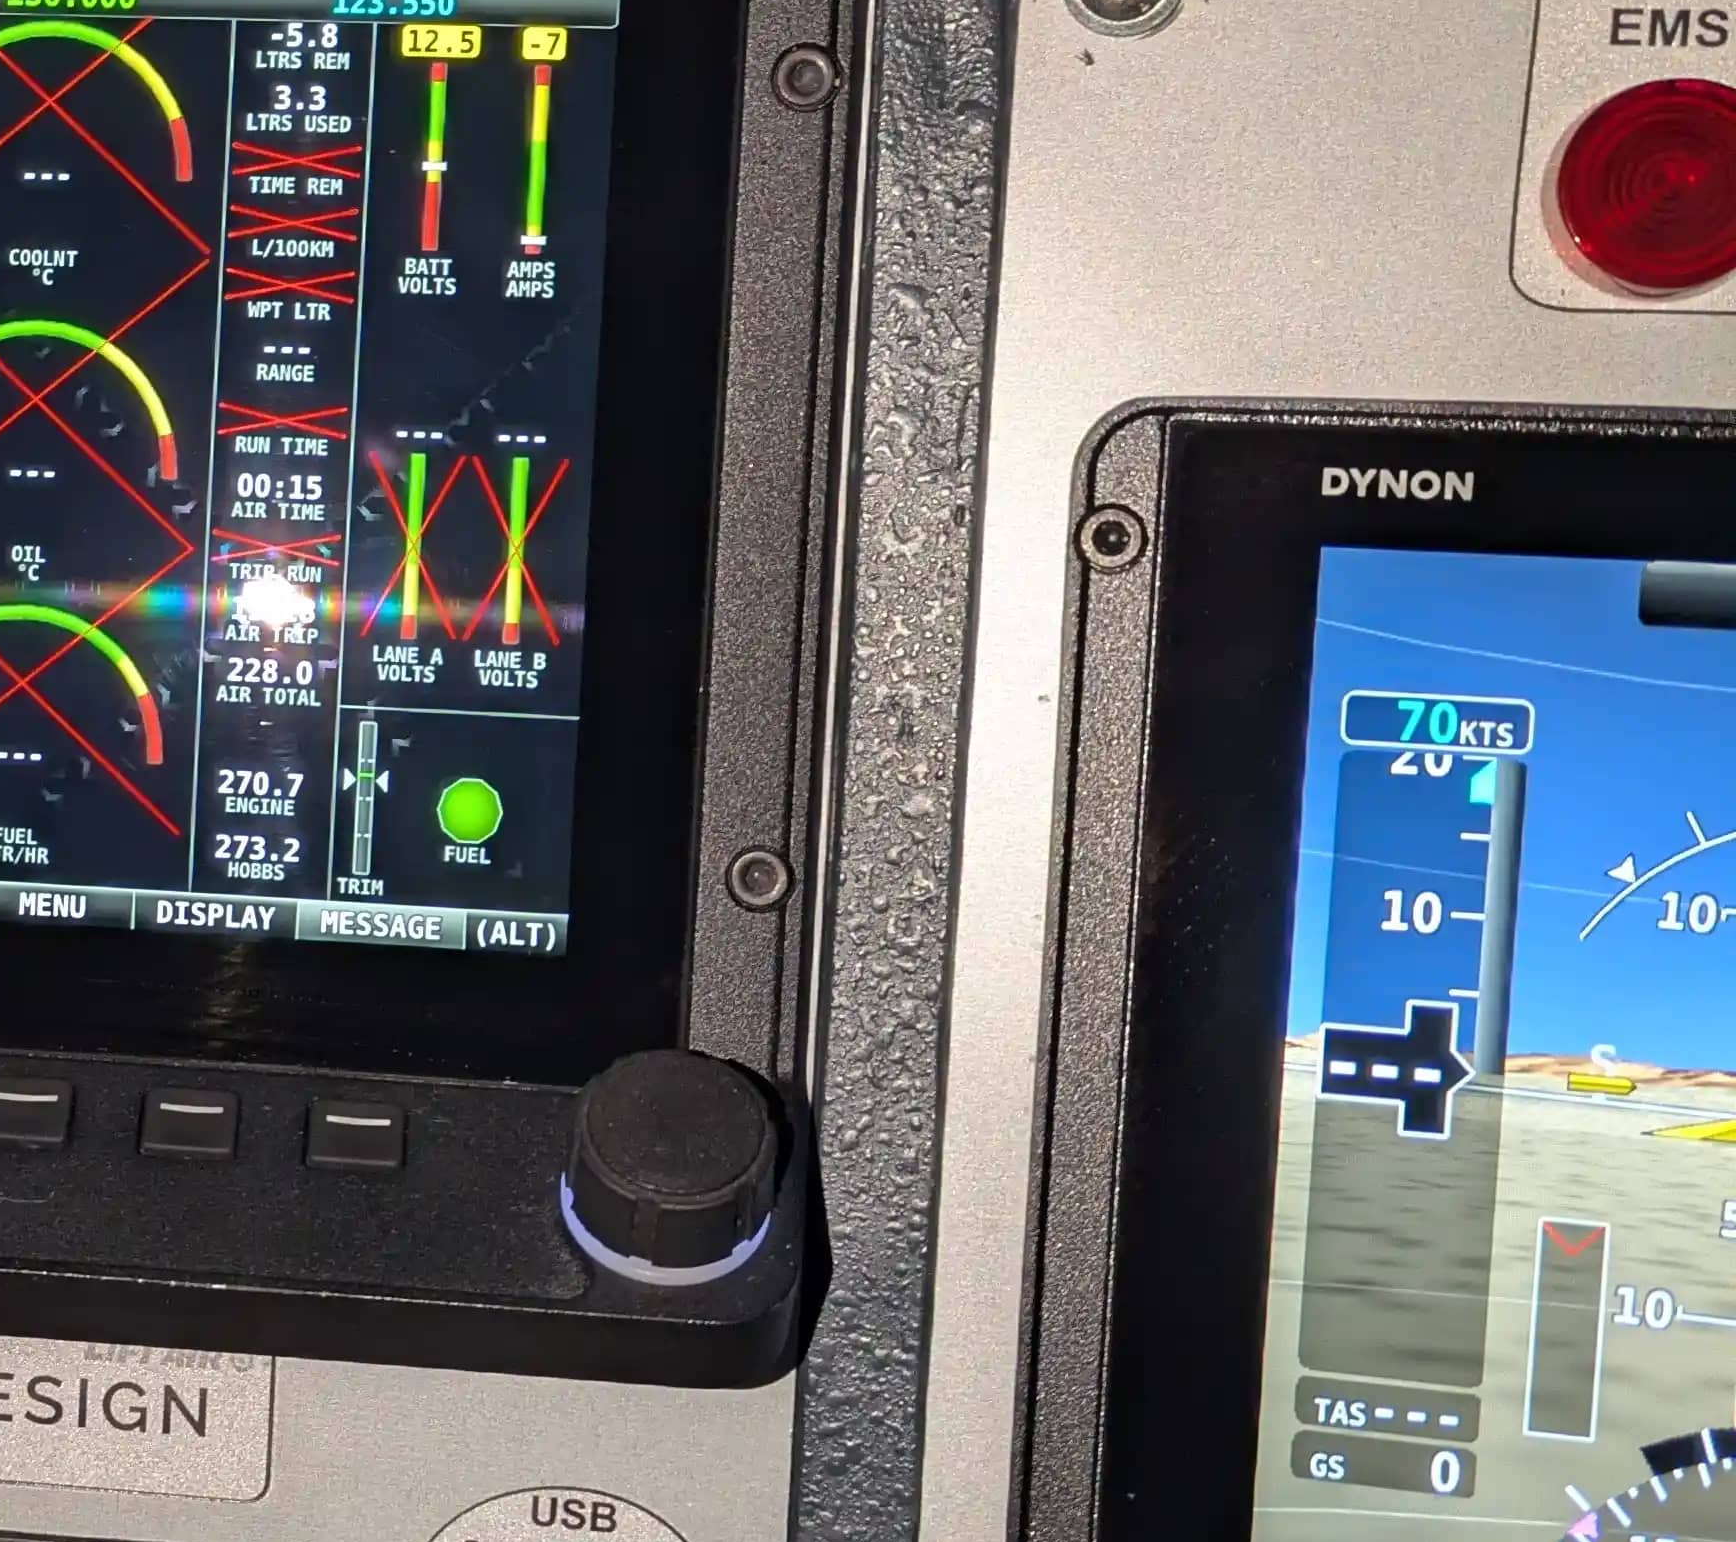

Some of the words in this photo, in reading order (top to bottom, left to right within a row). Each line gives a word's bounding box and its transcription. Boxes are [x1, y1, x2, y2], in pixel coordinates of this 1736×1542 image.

[271, 24, 338, 49] -5.8
[1610, 7, 1729, 48] EMS
[407, 30, 474, 54] 12.5
[256, 51, 304, 70] LTRS
[314, 52, 351, 72] REM
[274, 86, 327, 111] 3.3
[246, 112, 293, 132] LTRS
[304, 114, 352, 134] USED
[249, 176, 294, 194] TIME
[306, 178, 343, 196] REM
[9, 249, 78, 269] COOLNT
[251, 239, 334, 259] L/100KM
[404, 259, 452, 278] BATT
[506, 261, 556, 280] AMPS
[397, 276, 457, 296] VOLTS
[505, 280, 554, 299] AMPS
[247, 301, 282, 319] WPT
[293, 303, 331, 322] LTR
[256, 364, 314, 383] RANGE
[235, 436, 270, 456] RUN
[281, 438, 328, 457] TIME
[236, 475, 322, 501] 00:15
[1321, 466, 1474, 501] DYNON
[231, 501, 267, 520] AIR
[279, 502, 325, 522] TIME
[11, 546, 46, 564] OIL
[372, 646, 420, 666] LANE
[474, 649, 522, 669] LANE
[226, 659, 313, 685] 228.0
[376, 664, 436, 684] VOLTS
[479, 668, 538, 689] VOLTS
[216, 686, 252, 705] AIR
[263, 688, 322, 708] TOTAL
[217, 771, 304, 798] 270.7
[224, 796, 296, 817] ENGINE
[214, 835, 301, 863] 273.2
[444, 845, 491, 866] FUEL
[226, 862, 286, 882] HOBBS
[336, 876, 383, 897] TRIM
[19, 891, 86, 919] MENU
[1380, 889, 1443, 933] 10
[1657, 891, 1718, 934] 10
[156, 900, 276, 932] DISPLAY
[320, 910, 442, 942] MESSAGE
[476, 920, 557, 952] (ALT)
[1611, 1286, 1676, 1330] 10
[1314, 1397, 1366, 1427] TAS
[1310, 1453, 1345, 1479] GS
[1431, 1451, 1460, 1493] 0
[530, 1495, 618, 1533] USB
